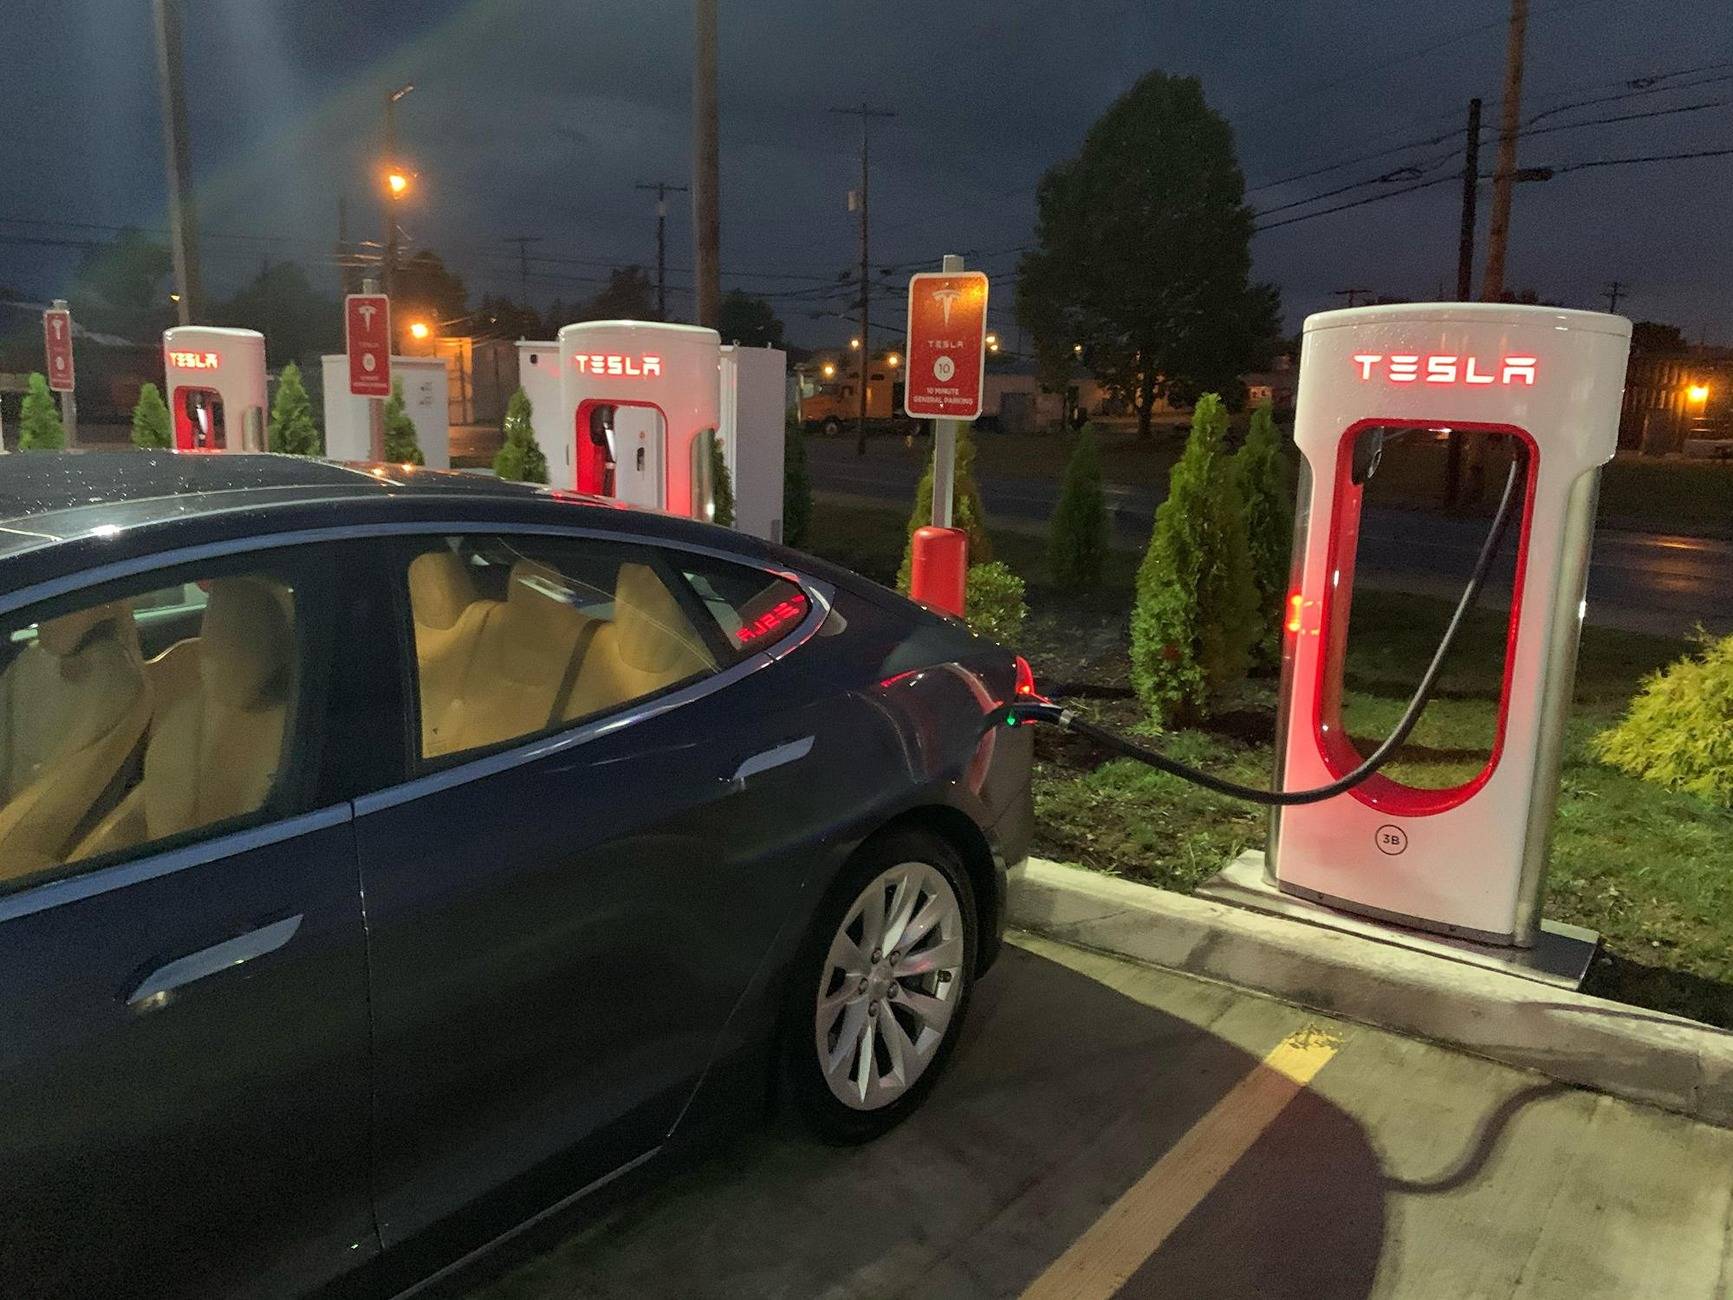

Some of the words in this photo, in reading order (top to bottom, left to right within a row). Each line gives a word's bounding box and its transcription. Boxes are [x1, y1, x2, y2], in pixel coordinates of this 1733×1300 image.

[928, 340, 964, 349] TESLA
[169, 352, 218, 368] TESLA
[575, 355, 661, 376] TESLA
[938, 363, 951, 374] 10
[1353, 355, 1537, 385] TESLA
[1383, 834, 1400, 845] 3B
